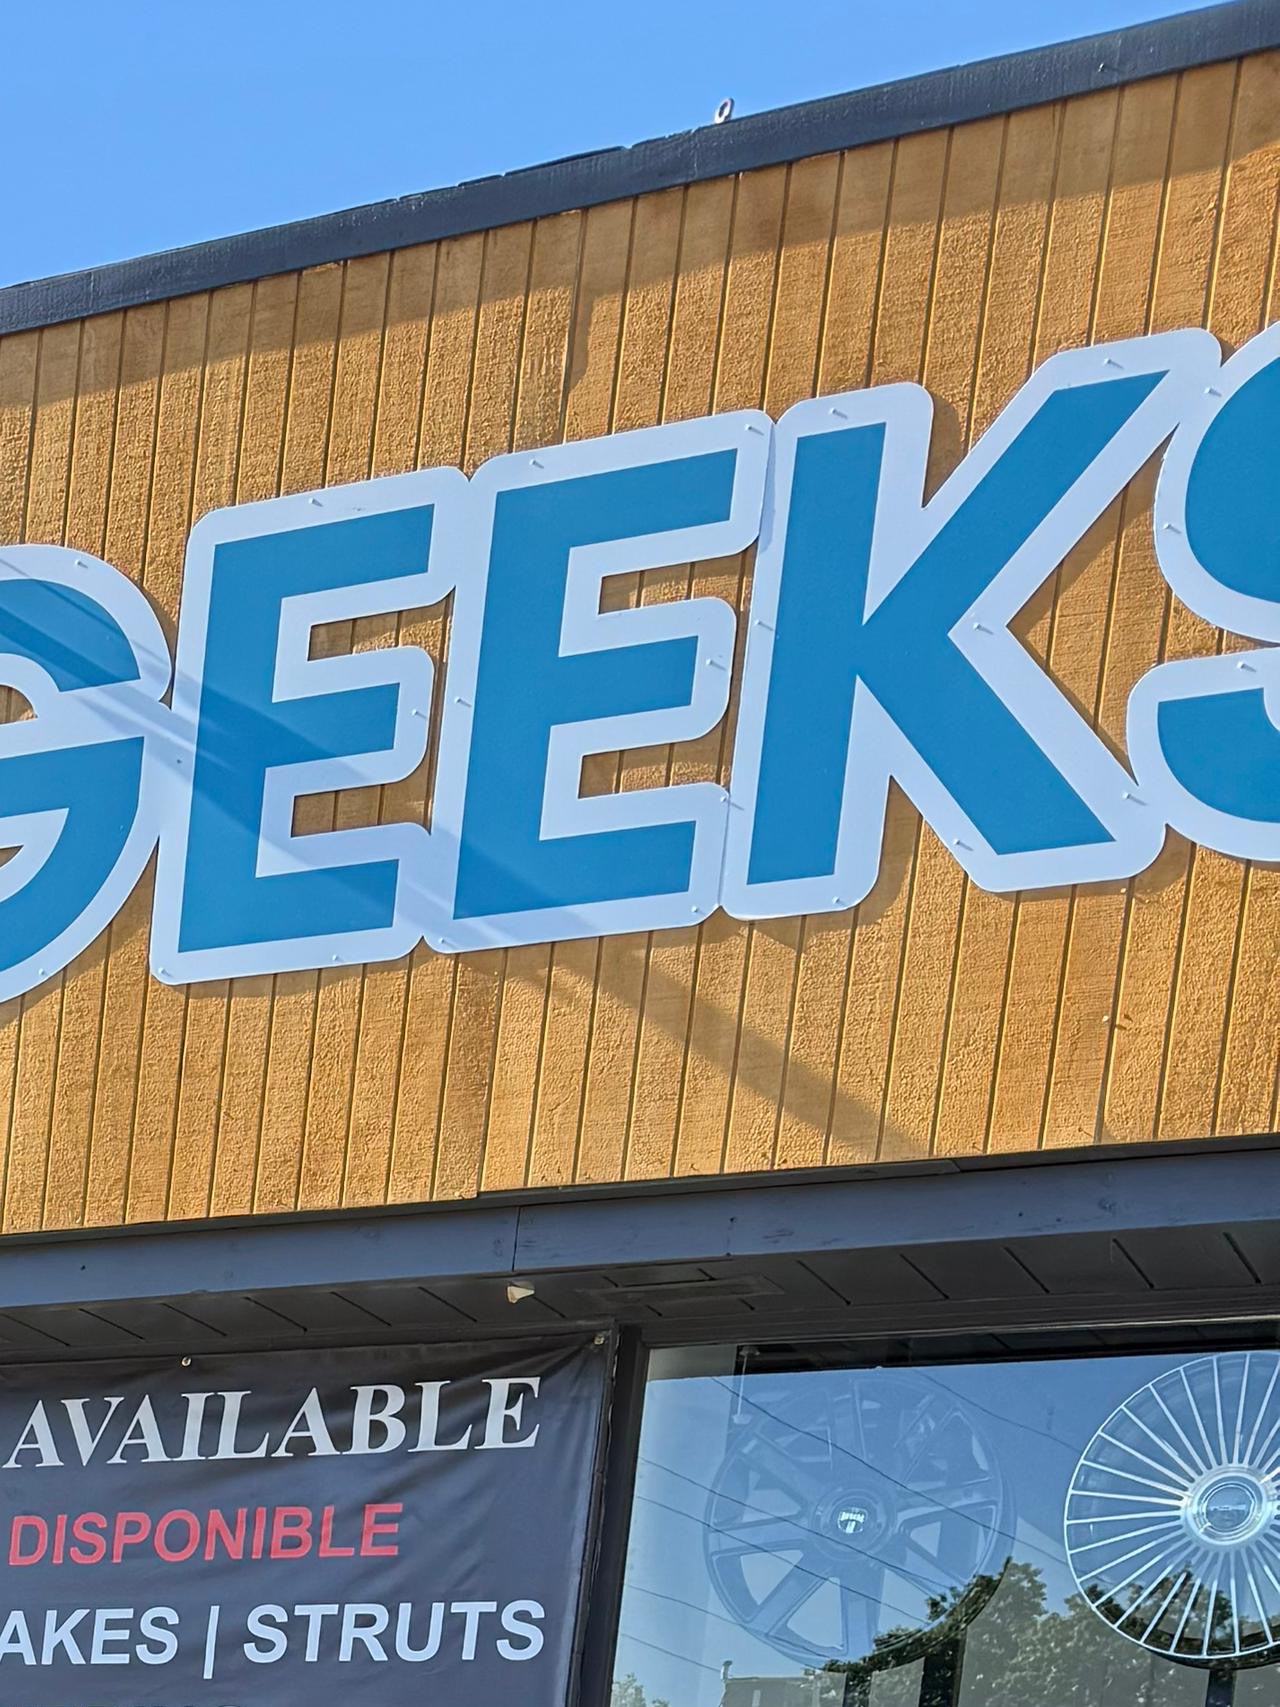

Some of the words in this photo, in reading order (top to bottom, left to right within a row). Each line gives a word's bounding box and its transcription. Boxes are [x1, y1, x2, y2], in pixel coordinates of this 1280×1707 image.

[6, 1377, 542, 1471] AVAILABLE
[8, 1502, 404, 1569] DISPONIBLE
[243, 1598, 546, 1664] STRUTS
